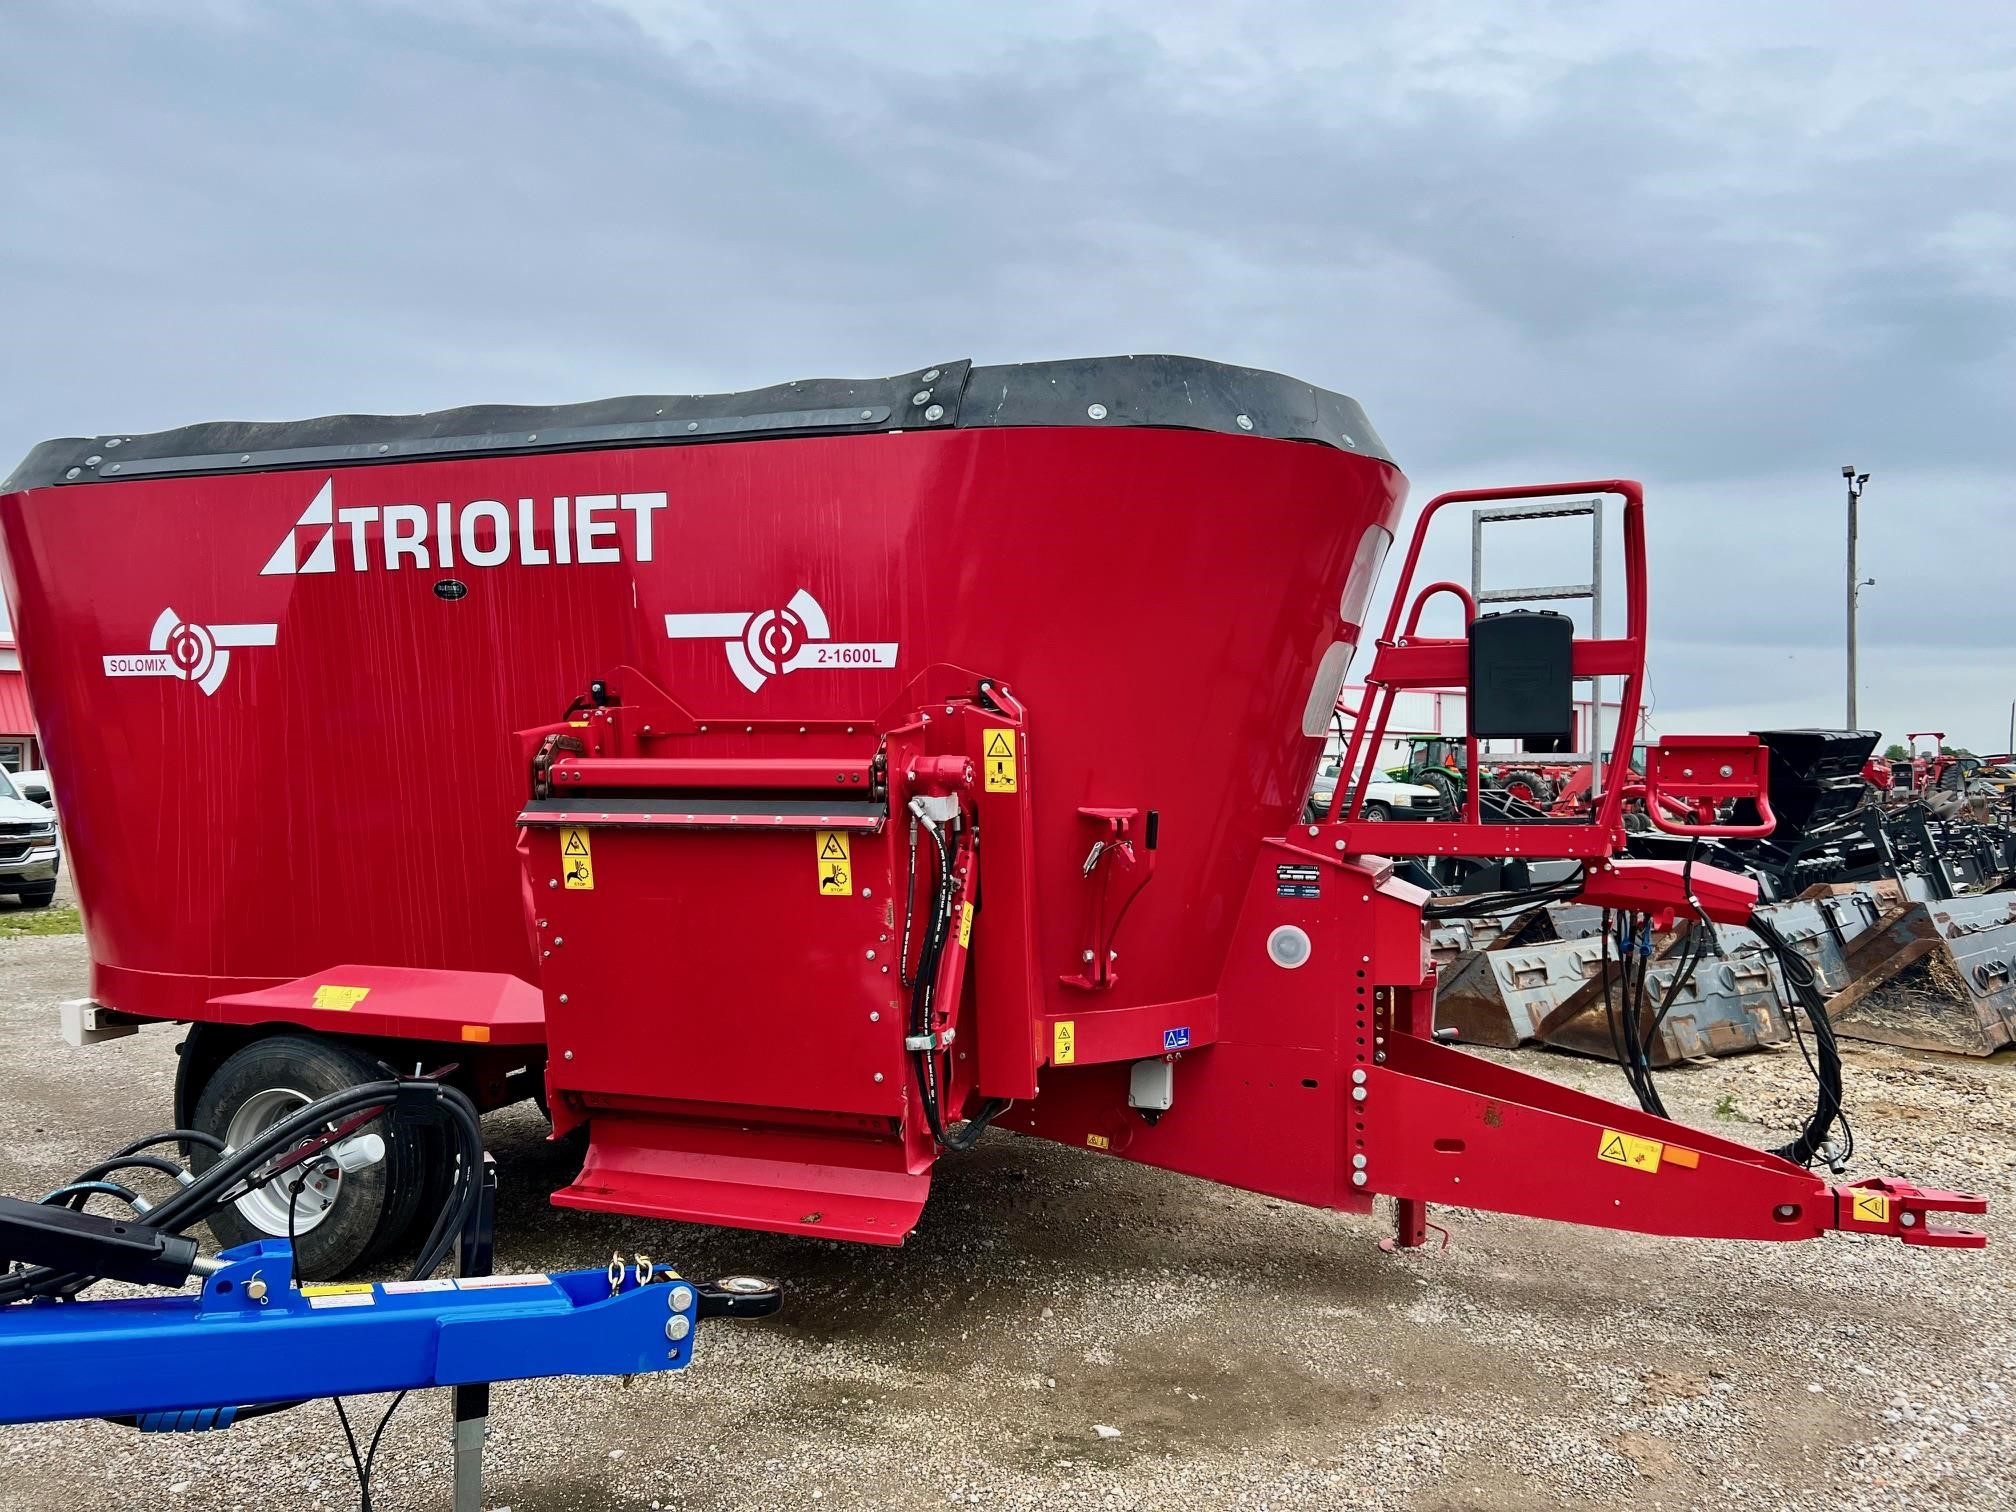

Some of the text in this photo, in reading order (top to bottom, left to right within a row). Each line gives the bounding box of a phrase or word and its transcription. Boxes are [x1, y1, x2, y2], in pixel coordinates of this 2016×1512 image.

[337, 491, 668, 572] TRIOLIET
[818, 648, 882, 663] 2-1600L
[110, 659, 166, 672] SOLOMIX
